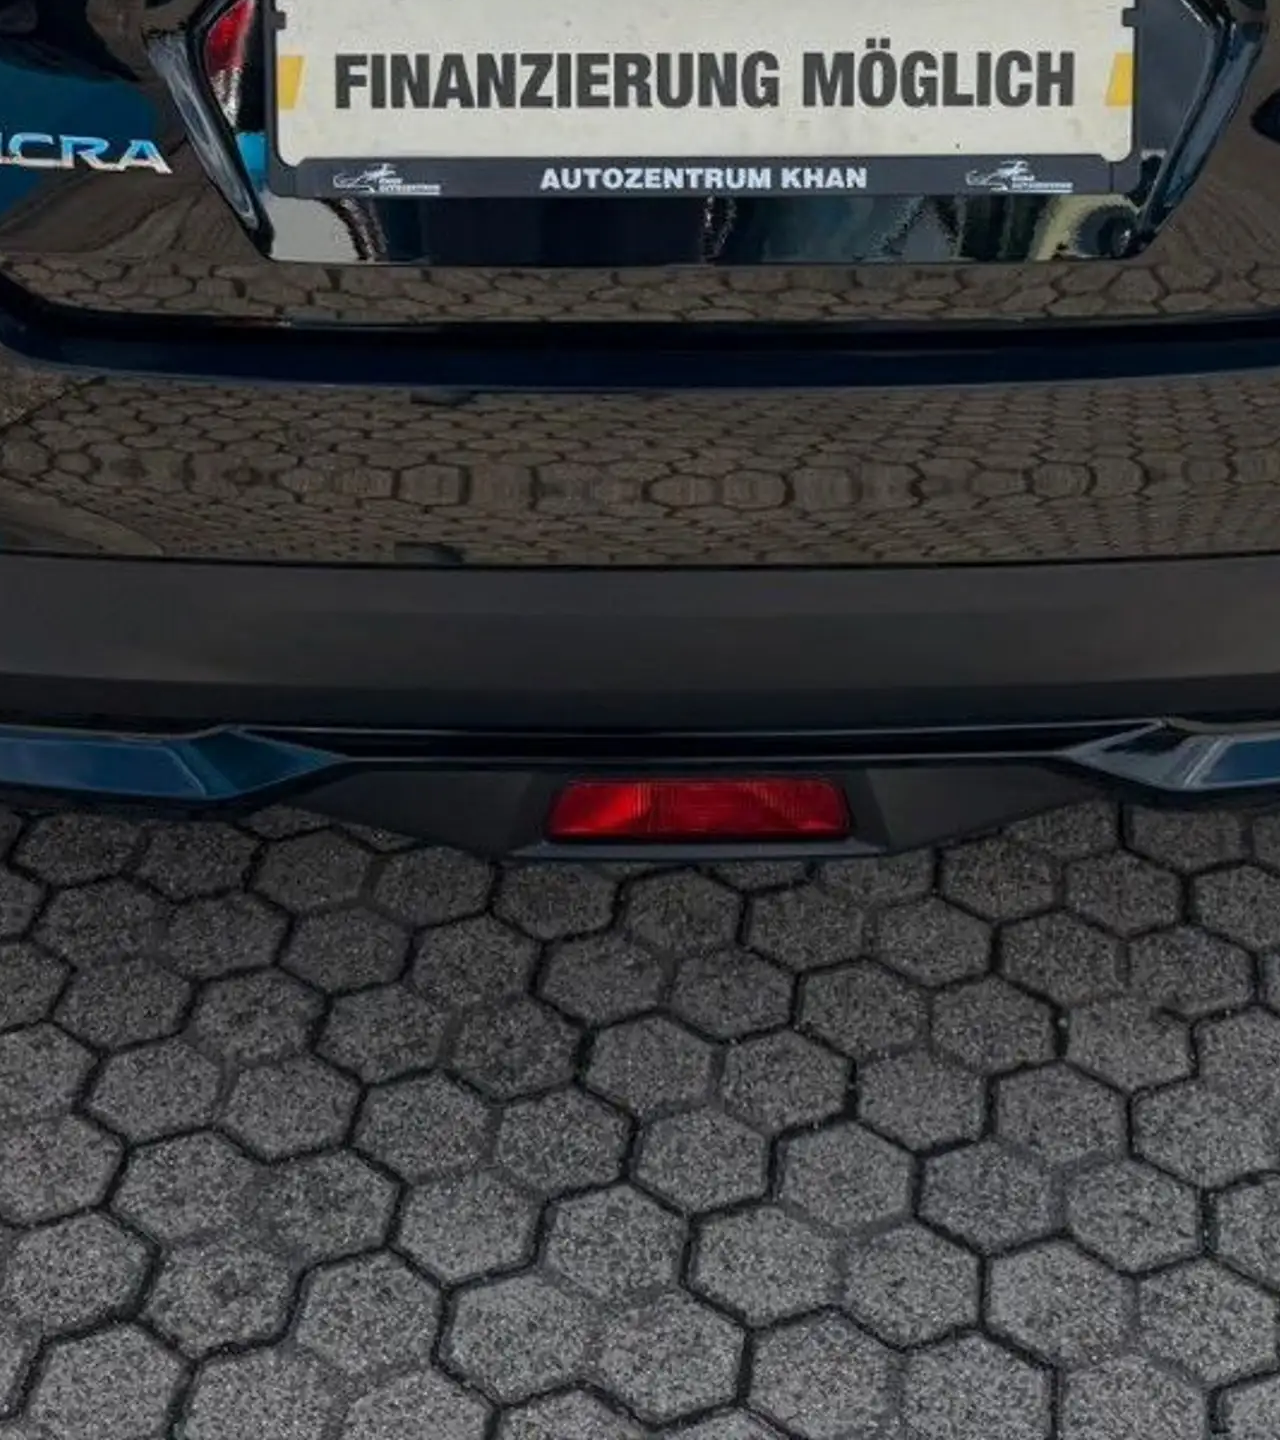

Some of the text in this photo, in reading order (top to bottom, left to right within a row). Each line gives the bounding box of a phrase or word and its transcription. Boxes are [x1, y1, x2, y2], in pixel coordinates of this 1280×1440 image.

[334, 36, 1076, 109] FINANZIERUNG MÖGLICH
[539, 167, 868, 191] AUTOZENTRUM KHAN
